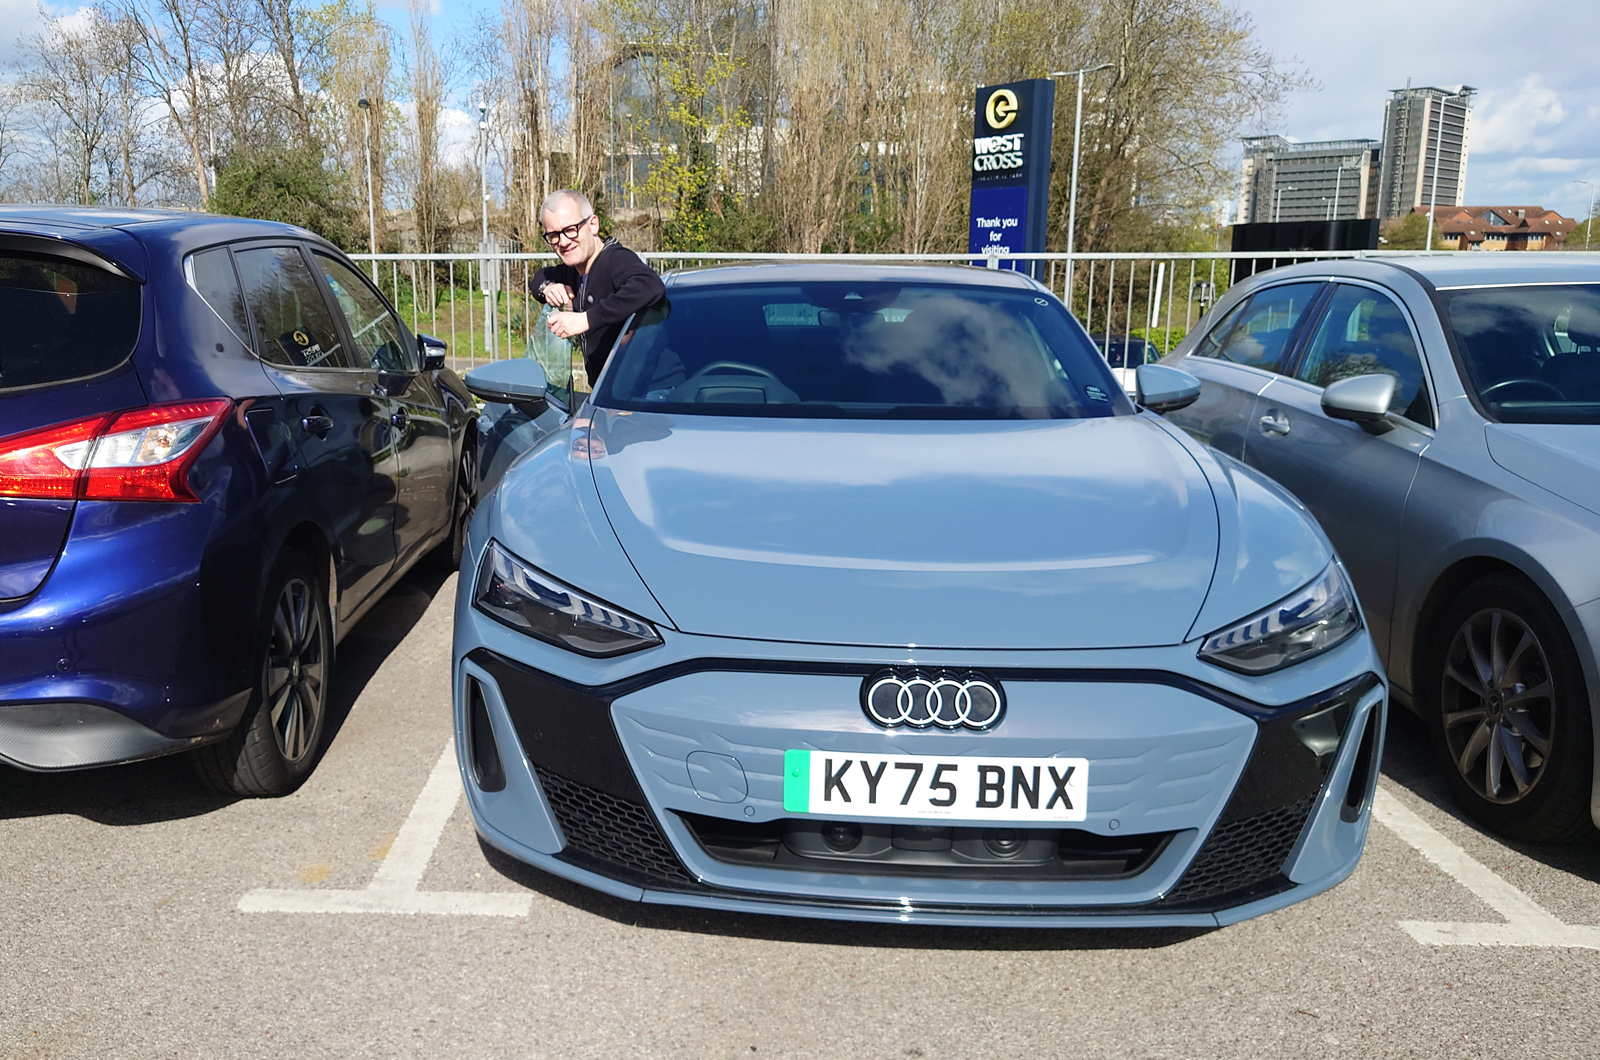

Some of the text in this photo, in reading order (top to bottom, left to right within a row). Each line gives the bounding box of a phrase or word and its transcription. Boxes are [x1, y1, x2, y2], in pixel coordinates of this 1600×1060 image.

[974, 152, 1023, 171] CROSS
[976, 217, 1018, 229] Thank you
[989, 230, 1002, 242] for
[824, 758, 1076, 810] KY75 BNX
